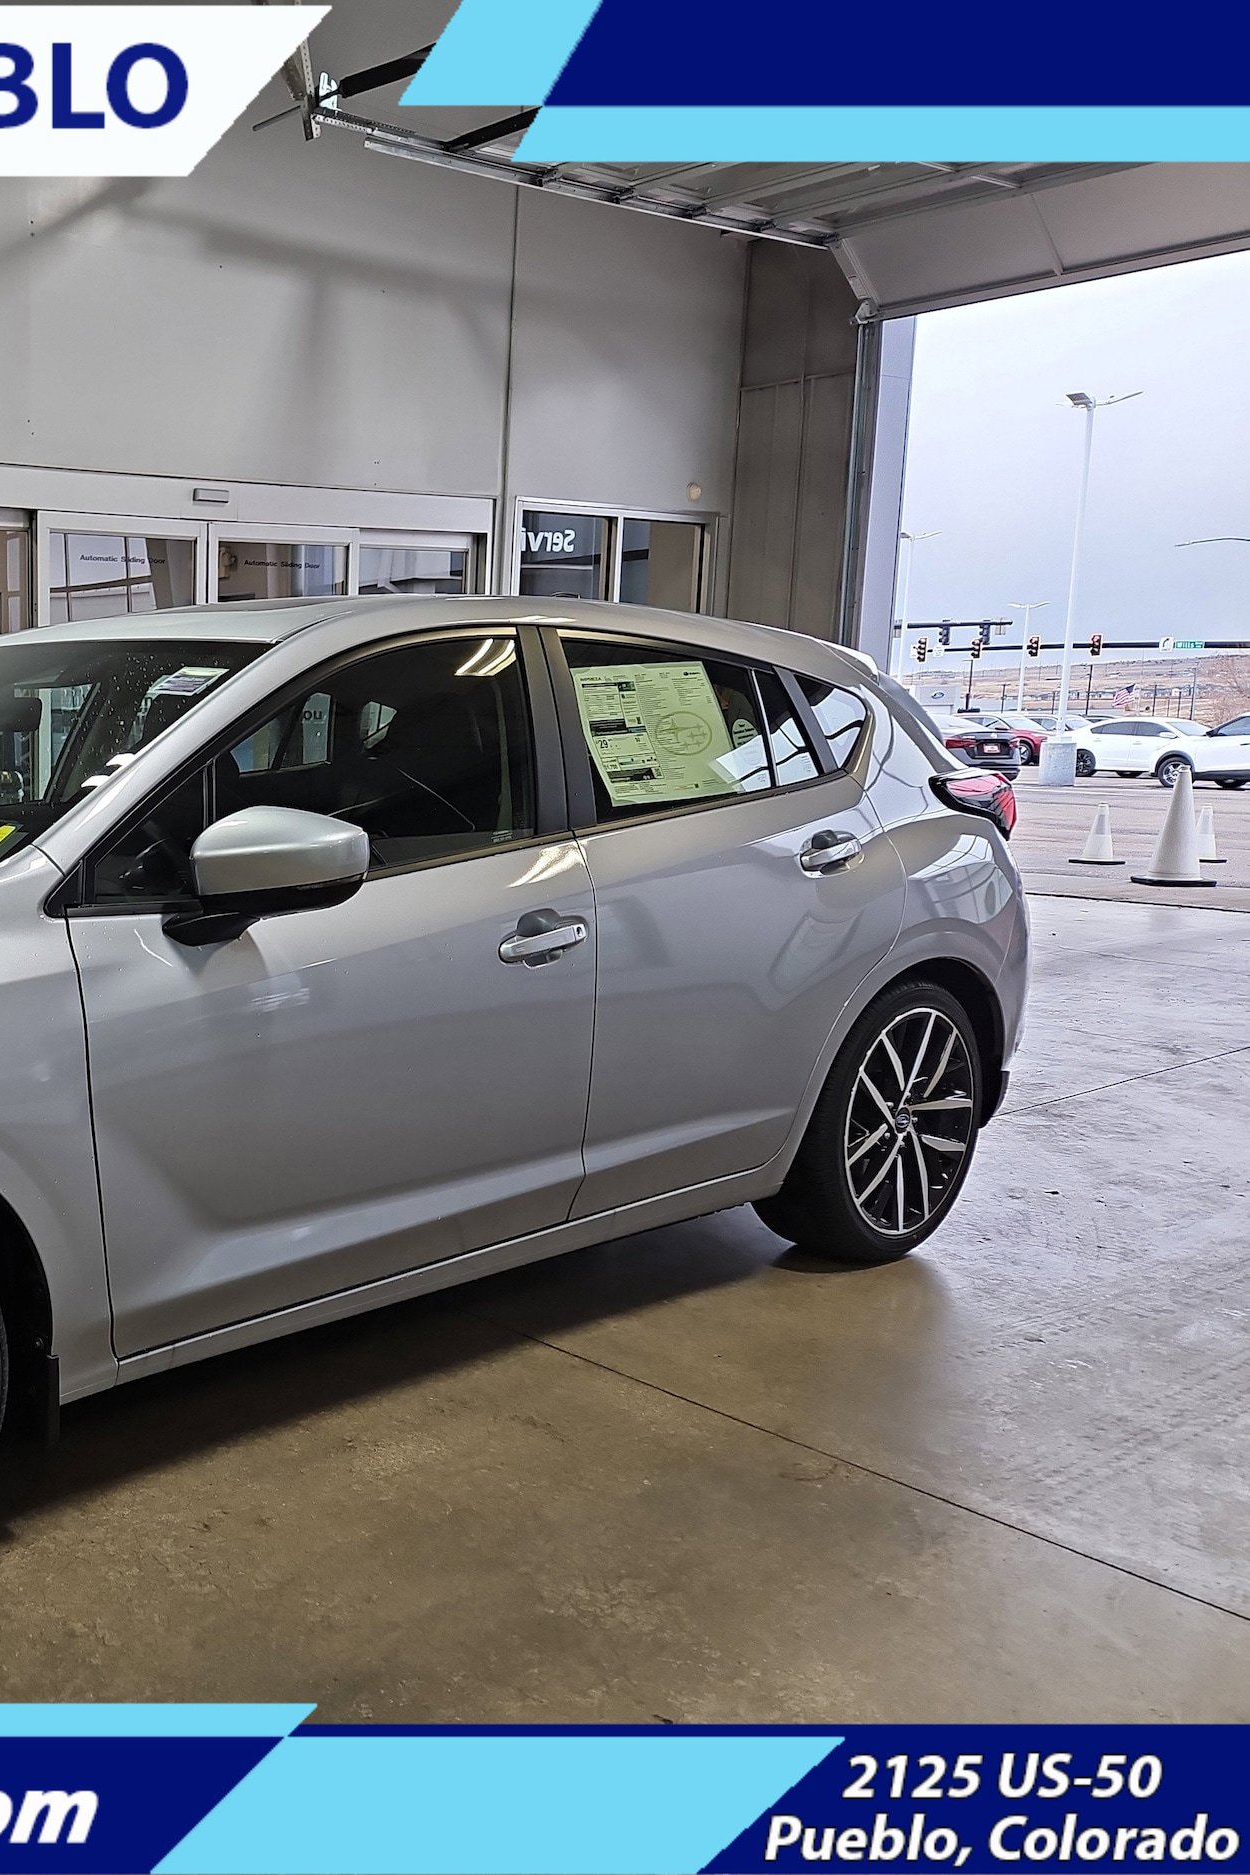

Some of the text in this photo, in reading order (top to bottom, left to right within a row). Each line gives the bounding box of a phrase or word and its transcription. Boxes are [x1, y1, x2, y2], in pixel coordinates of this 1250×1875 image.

[79, 554, 118, 563] Automatic
[147, 557, 166, 565] Door
[244, 559, 278, 568] Automatic
[304, 562, 321, 570] Door
[599, 739, 608, 749] 29
